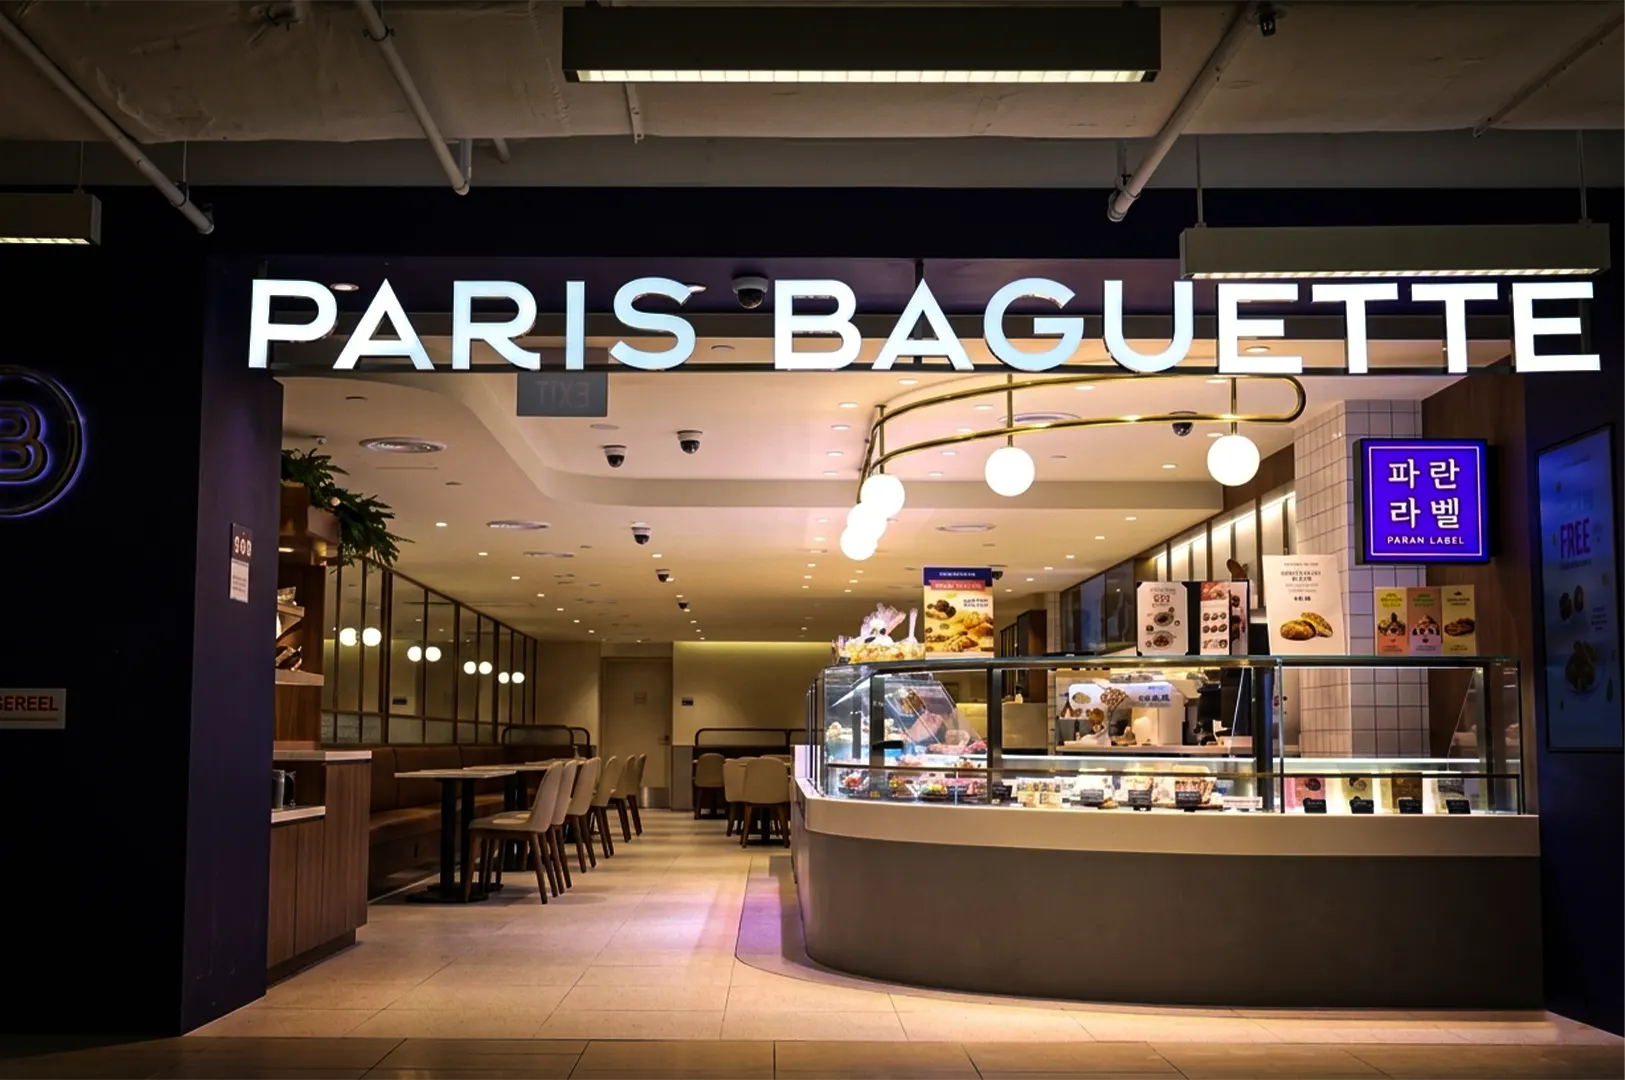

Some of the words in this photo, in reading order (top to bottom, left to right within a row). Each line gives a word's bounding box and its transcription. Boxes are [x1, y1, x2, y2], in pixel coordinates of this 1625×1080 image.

[248, 277, 696, 371] PARIS
[773, 277, 1602, 374] BAGUETTE
[1388, 458, 1460, 489] 파란
[1389, 497, 1460, 529] 라벨
[1387, 536, 1425, 545] PARAN
[1429, 536, 1465, 545] LABEL
[1559, 517, 1591, 559] FREE
[0, 696, 59, 711] EREEL
